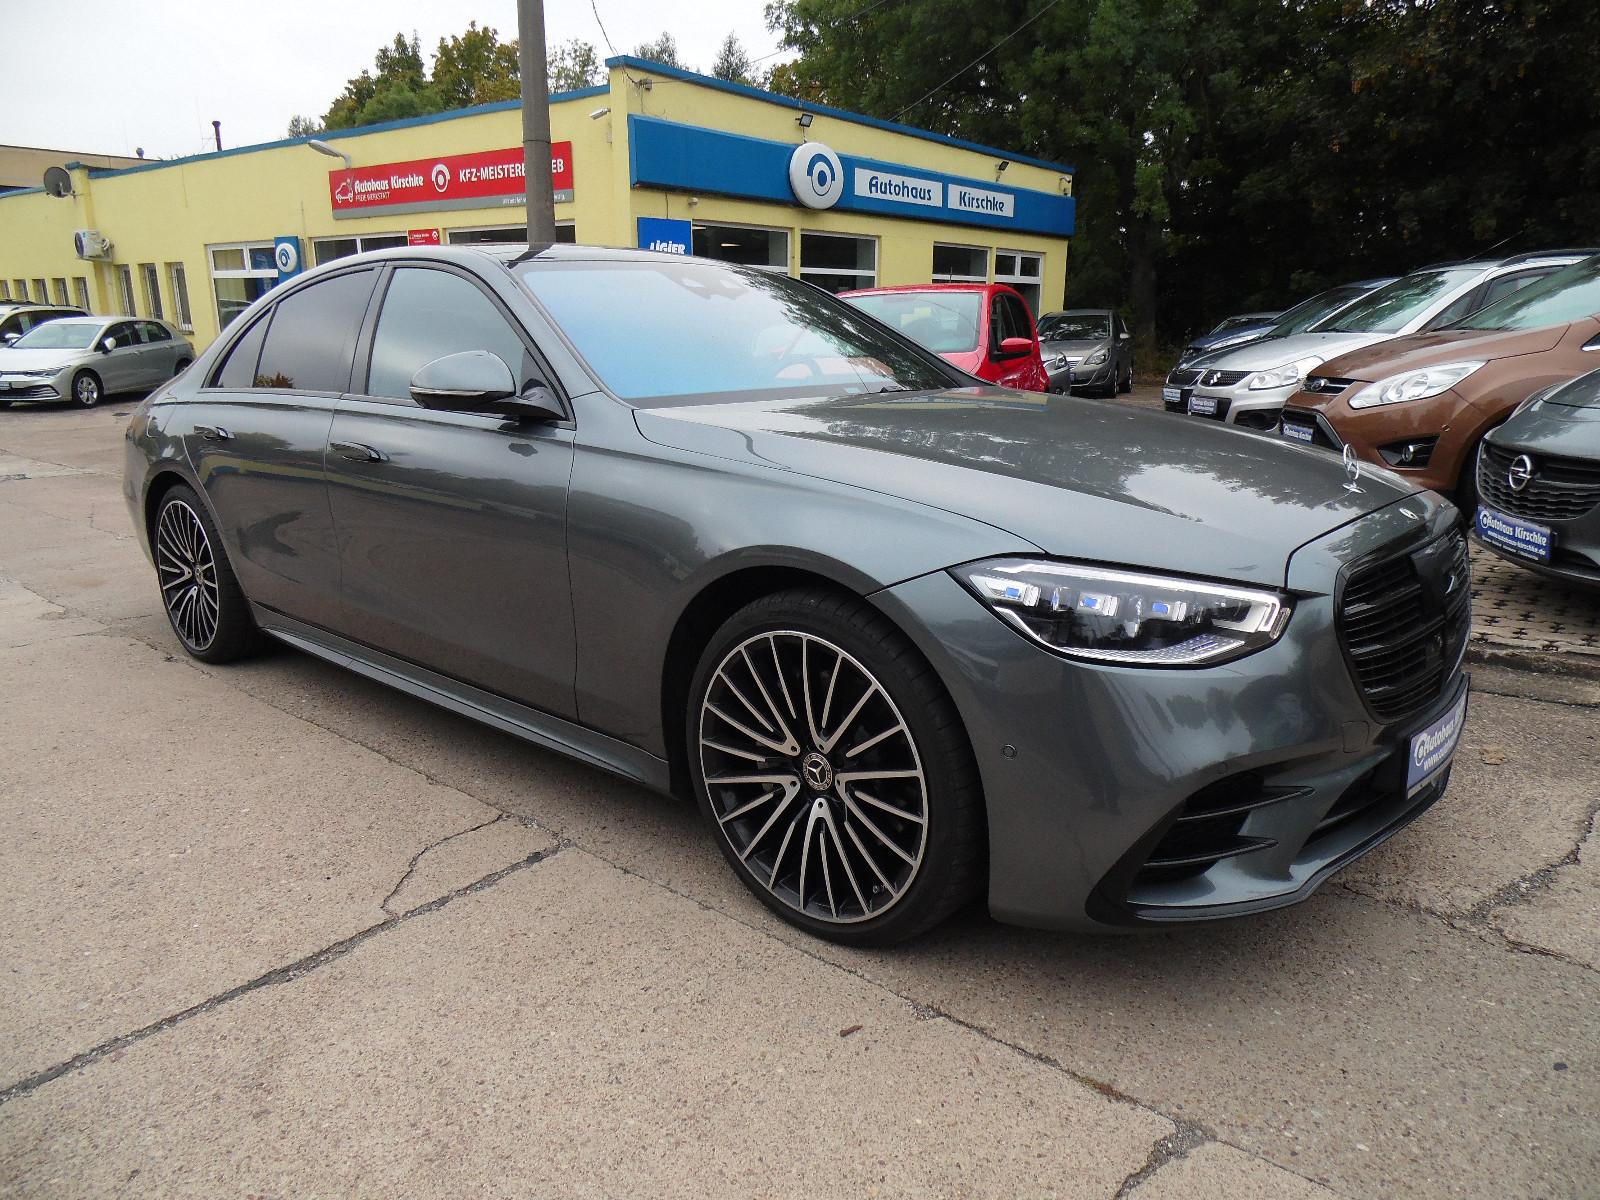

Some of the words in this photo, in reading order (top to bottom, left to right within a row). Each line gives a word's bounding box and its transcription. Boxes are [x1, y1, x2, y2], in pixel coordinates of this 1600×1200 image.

[460, 159, 564, 182] KFZ-MEISTEREB
[355, 178, 389, 194] Autohaus
[391, 174, 424, 189] Kirschke
[868, 175, 932, 201] Autohaus
[959, 191, 1005, 212] Kirschke
[1487, 516, 1513, 536] Autohaus
[1515, 526, 1547, 546] Kirschke
